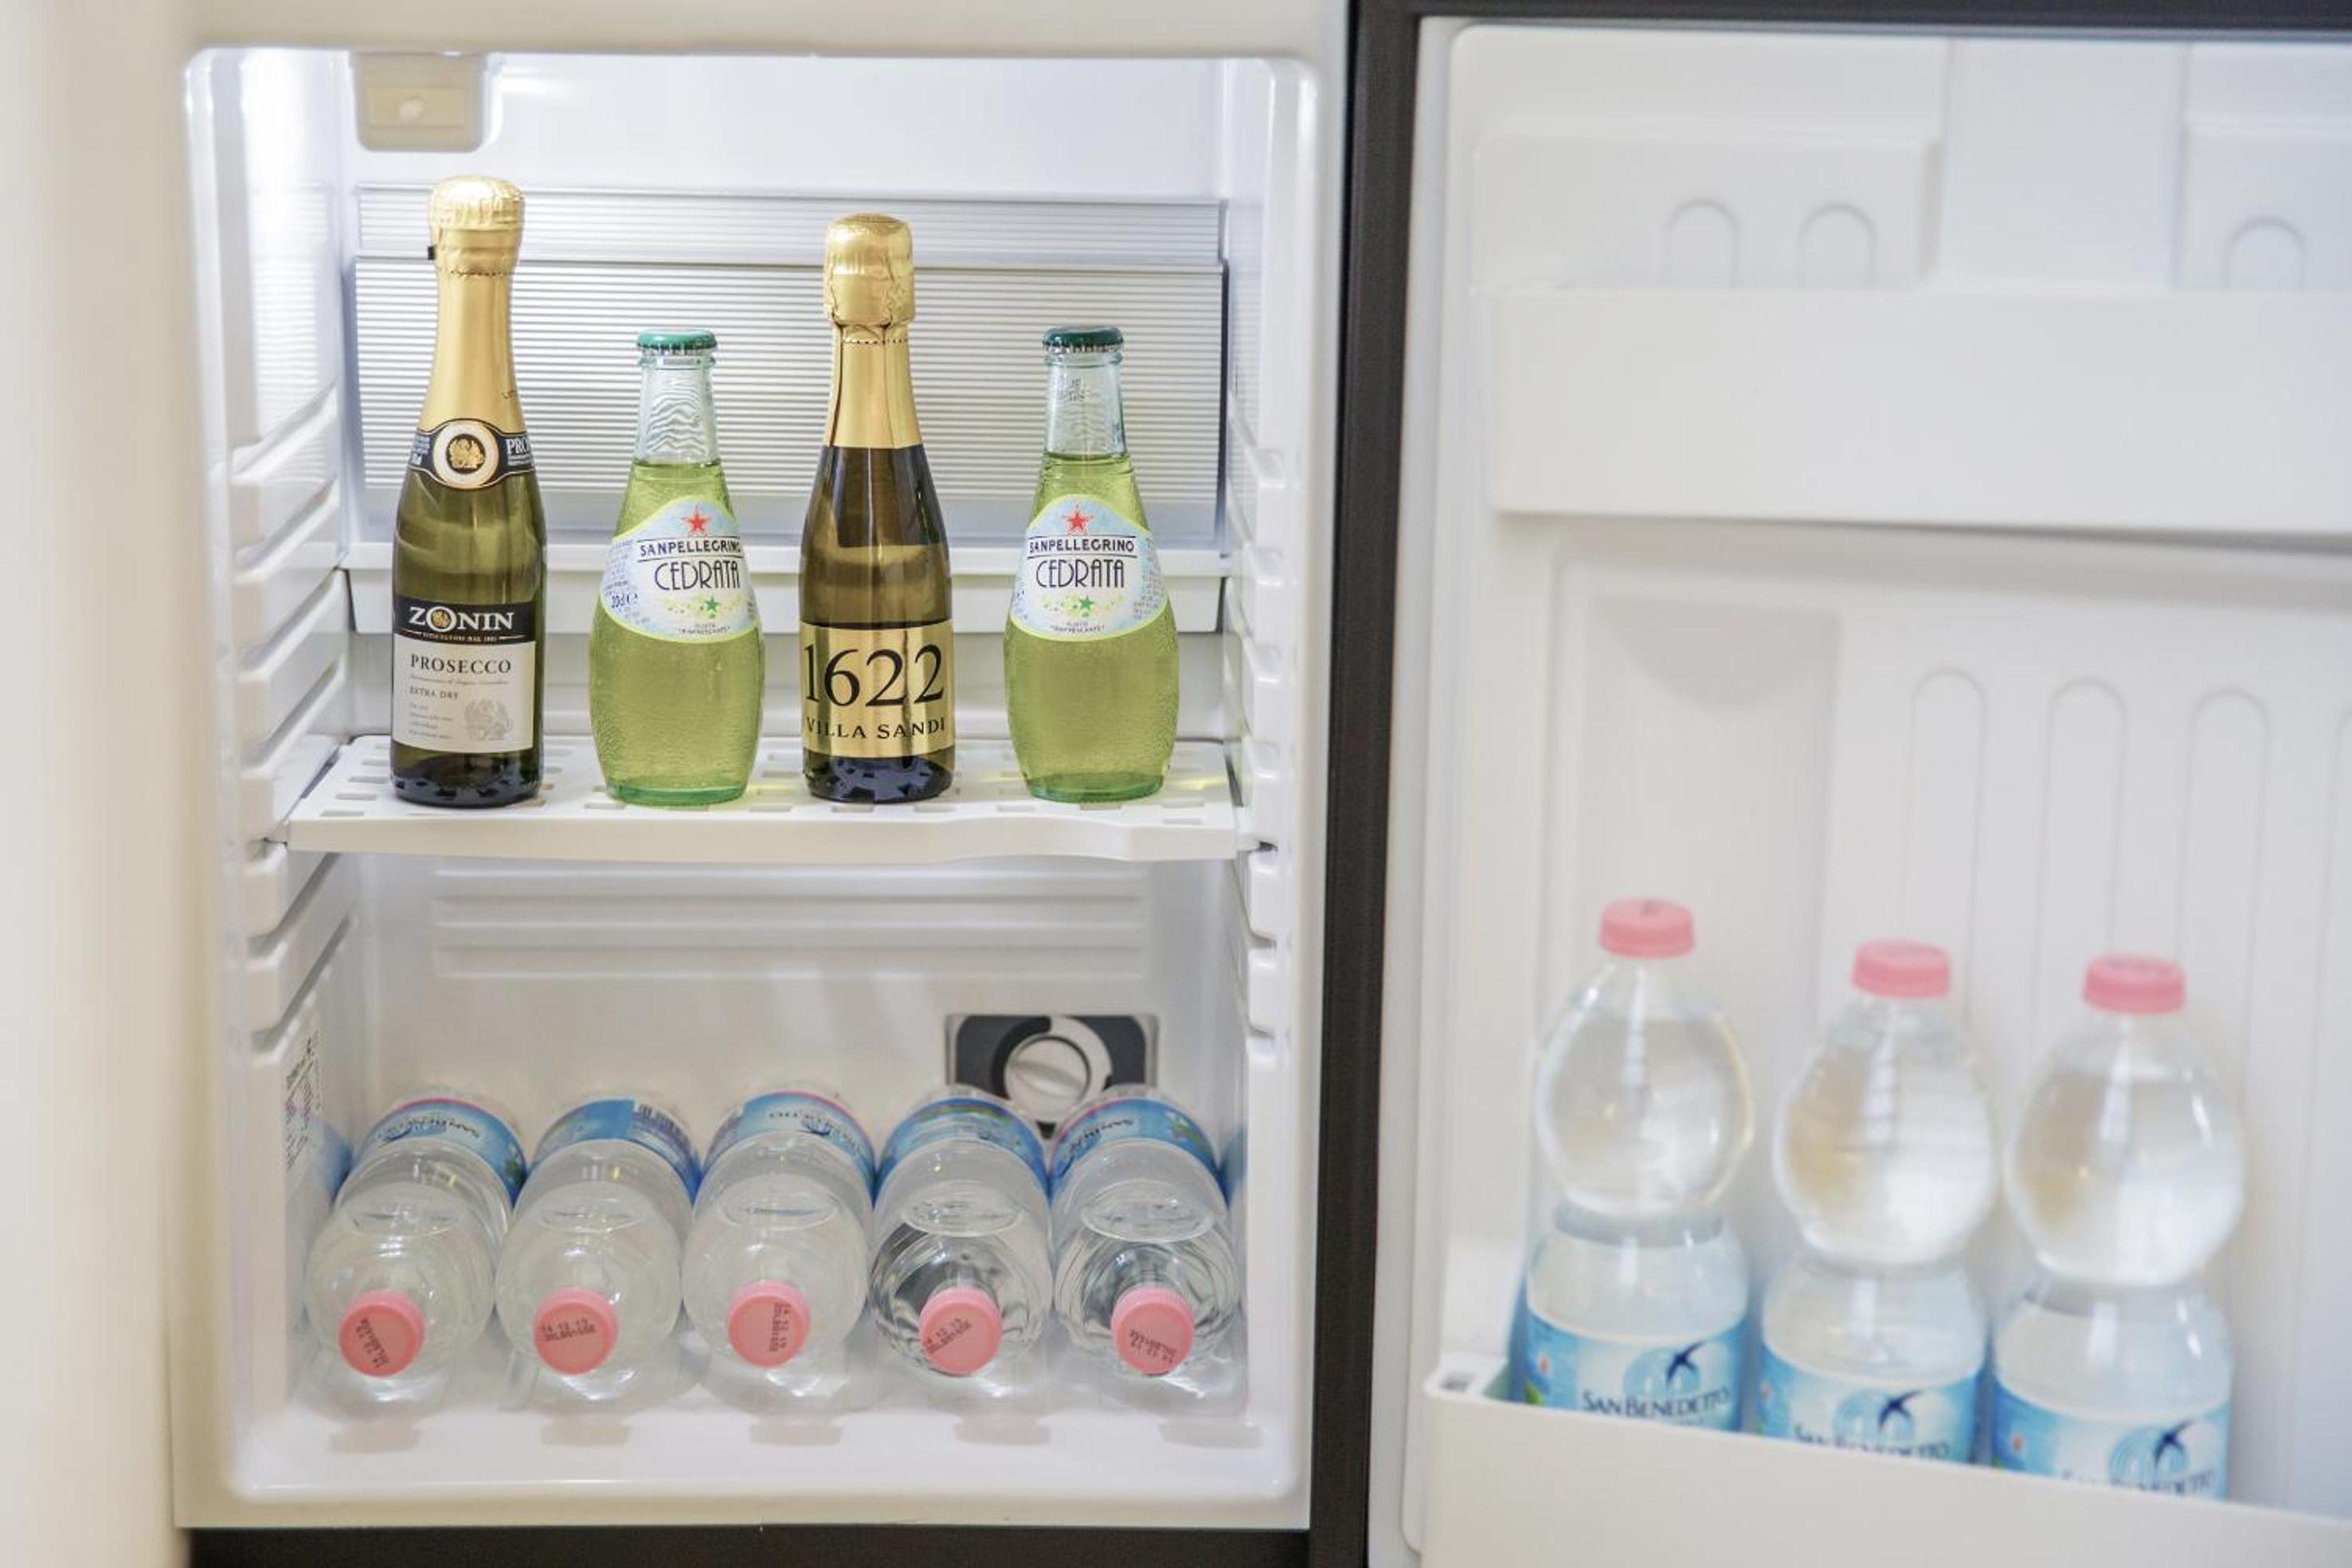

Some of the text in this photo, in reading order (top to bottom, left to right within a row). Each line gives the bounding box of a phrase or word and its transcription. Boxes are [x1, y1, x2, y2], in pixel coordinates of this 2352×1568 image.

[1029, 538, 1135, 553] SANPELLEGRINO
[654, 561, 742, 590] CEDRATA
[1035, 559, 1125, 588] CEDRATA
[409, 606, 515, 632] ZONIN
[410, 653, 511, 675] PROSECCO
[804, 643, 945, 708] 1622
[440, 690, 459, 700] DRY
[806, 716, 945, 739] VILLA SANDI
[1583, 1390, 1621, 1414] SAN
